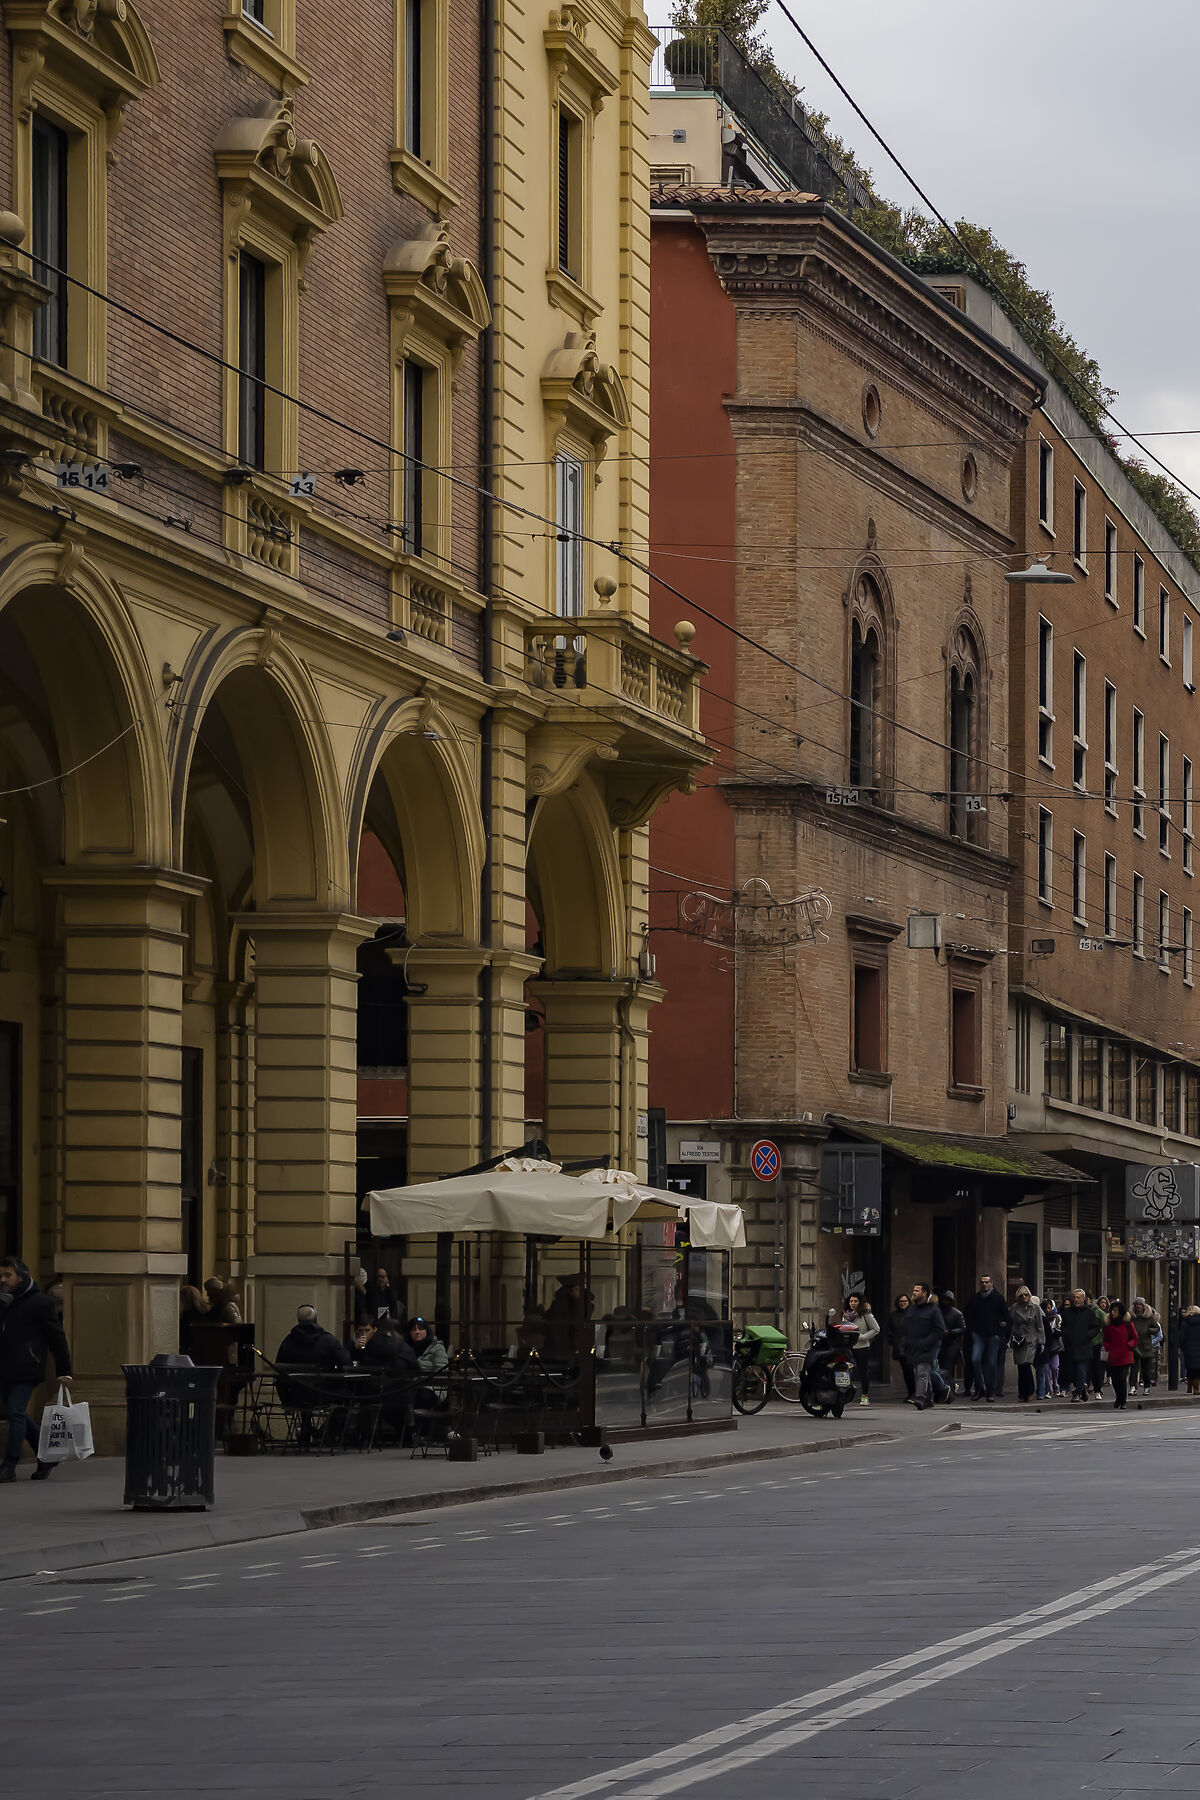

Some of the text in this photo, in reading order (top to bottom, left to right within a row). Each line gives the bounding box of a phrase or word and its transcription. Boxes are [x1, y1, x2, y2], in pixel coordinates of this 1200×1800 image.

[59, 471, 79, 487] 15
[84, 473, 108, 488] 14
[293, 481, 314, 495] 13
[828, 793, 840, 803] 15
[844, 794, 858, 803] 14
[967, 801, 980, 809] 13
